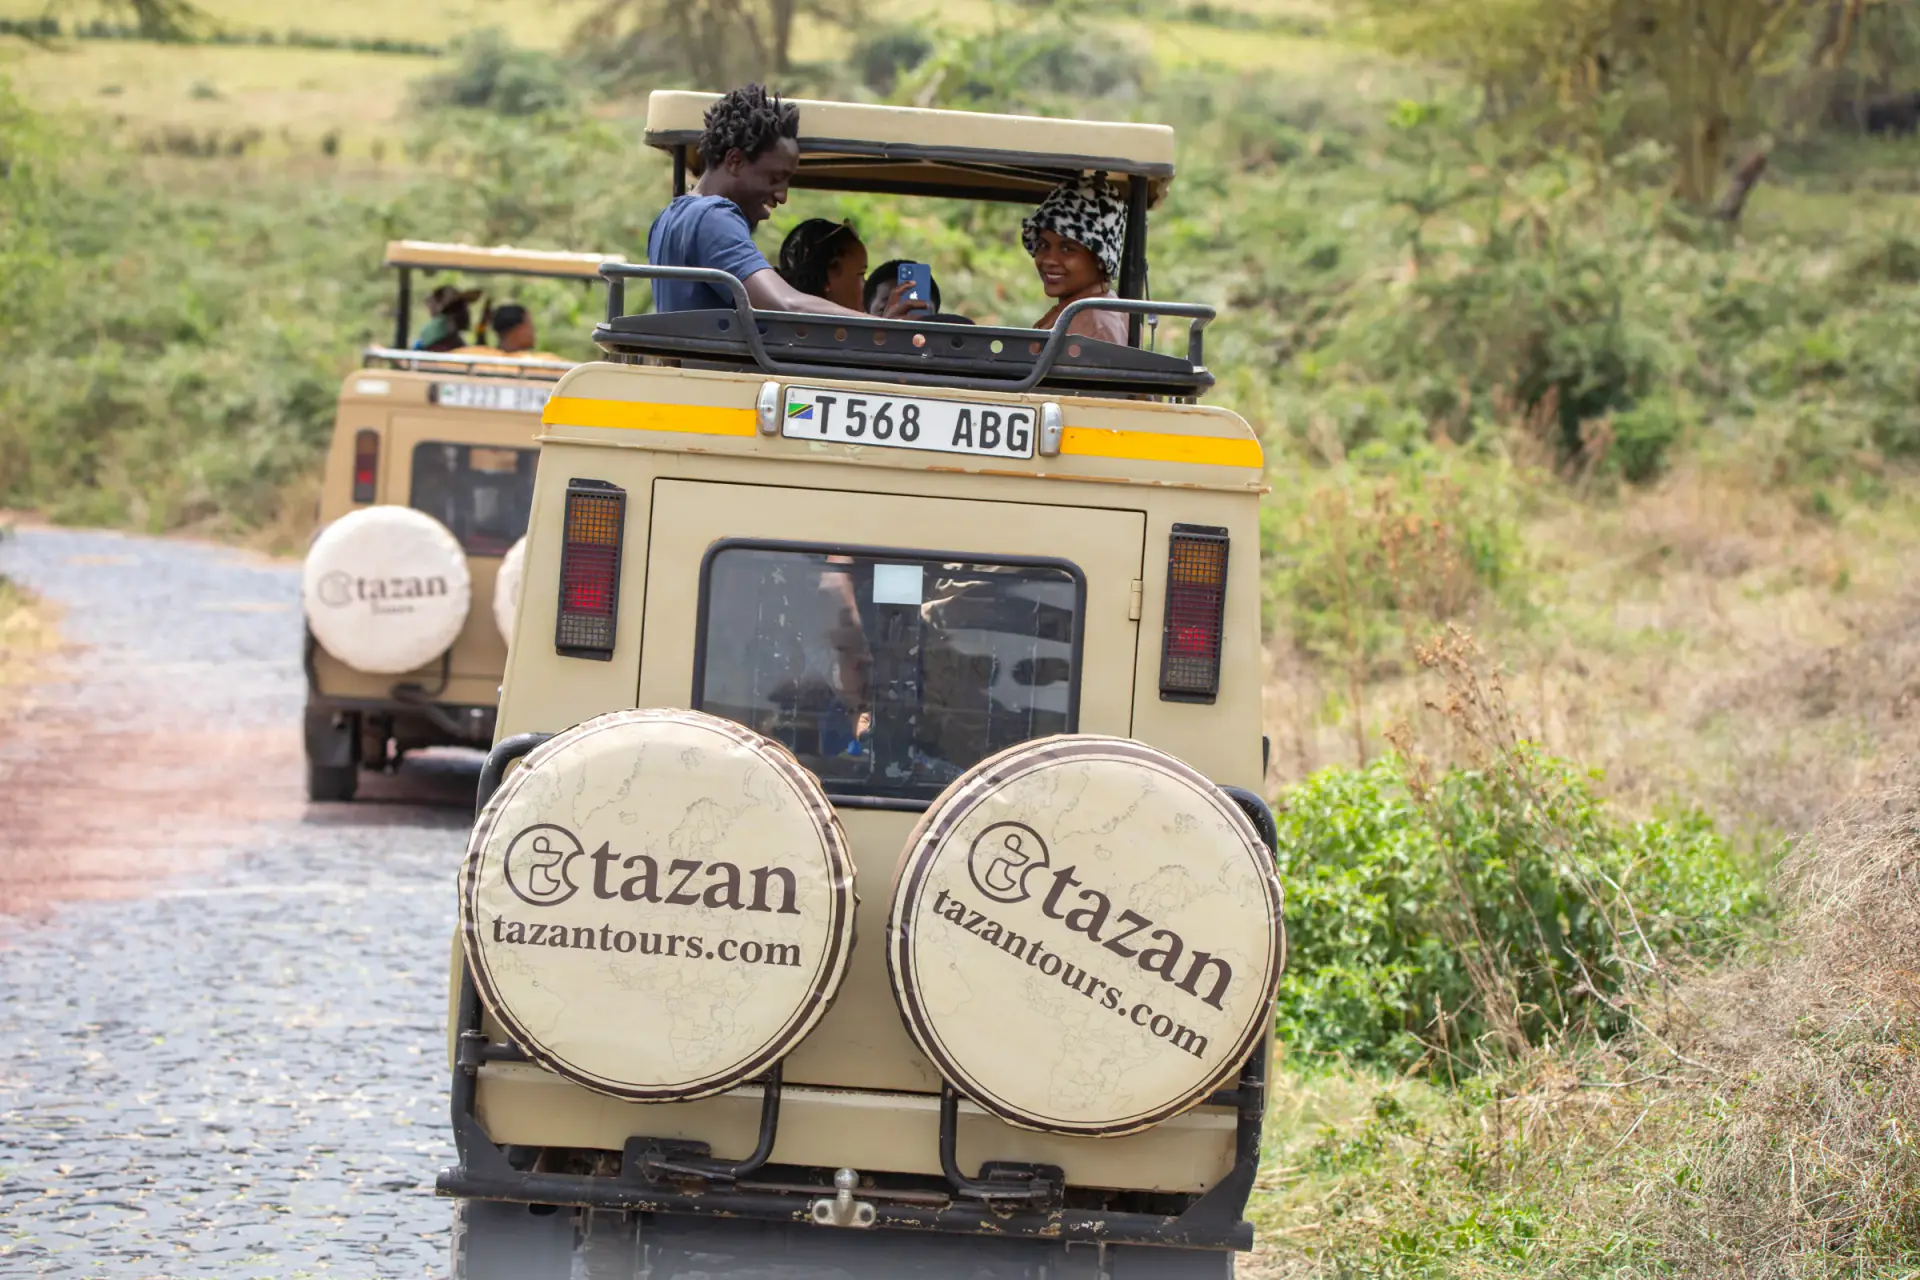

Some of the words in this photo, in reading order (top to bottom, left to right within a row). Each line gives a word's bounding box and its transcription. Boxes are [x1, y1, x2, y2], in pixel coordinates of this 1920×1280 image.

[951, 408, 1030, 452] ABG
[357, 574, 449, 601] tazan
[590, 840, 801, 915] tazan
[492, 914, 802, 967] tazantours.com
[1042, 865, 1233, 1012] tazan
[932, 888, 1209, 1060] tazantours.com
